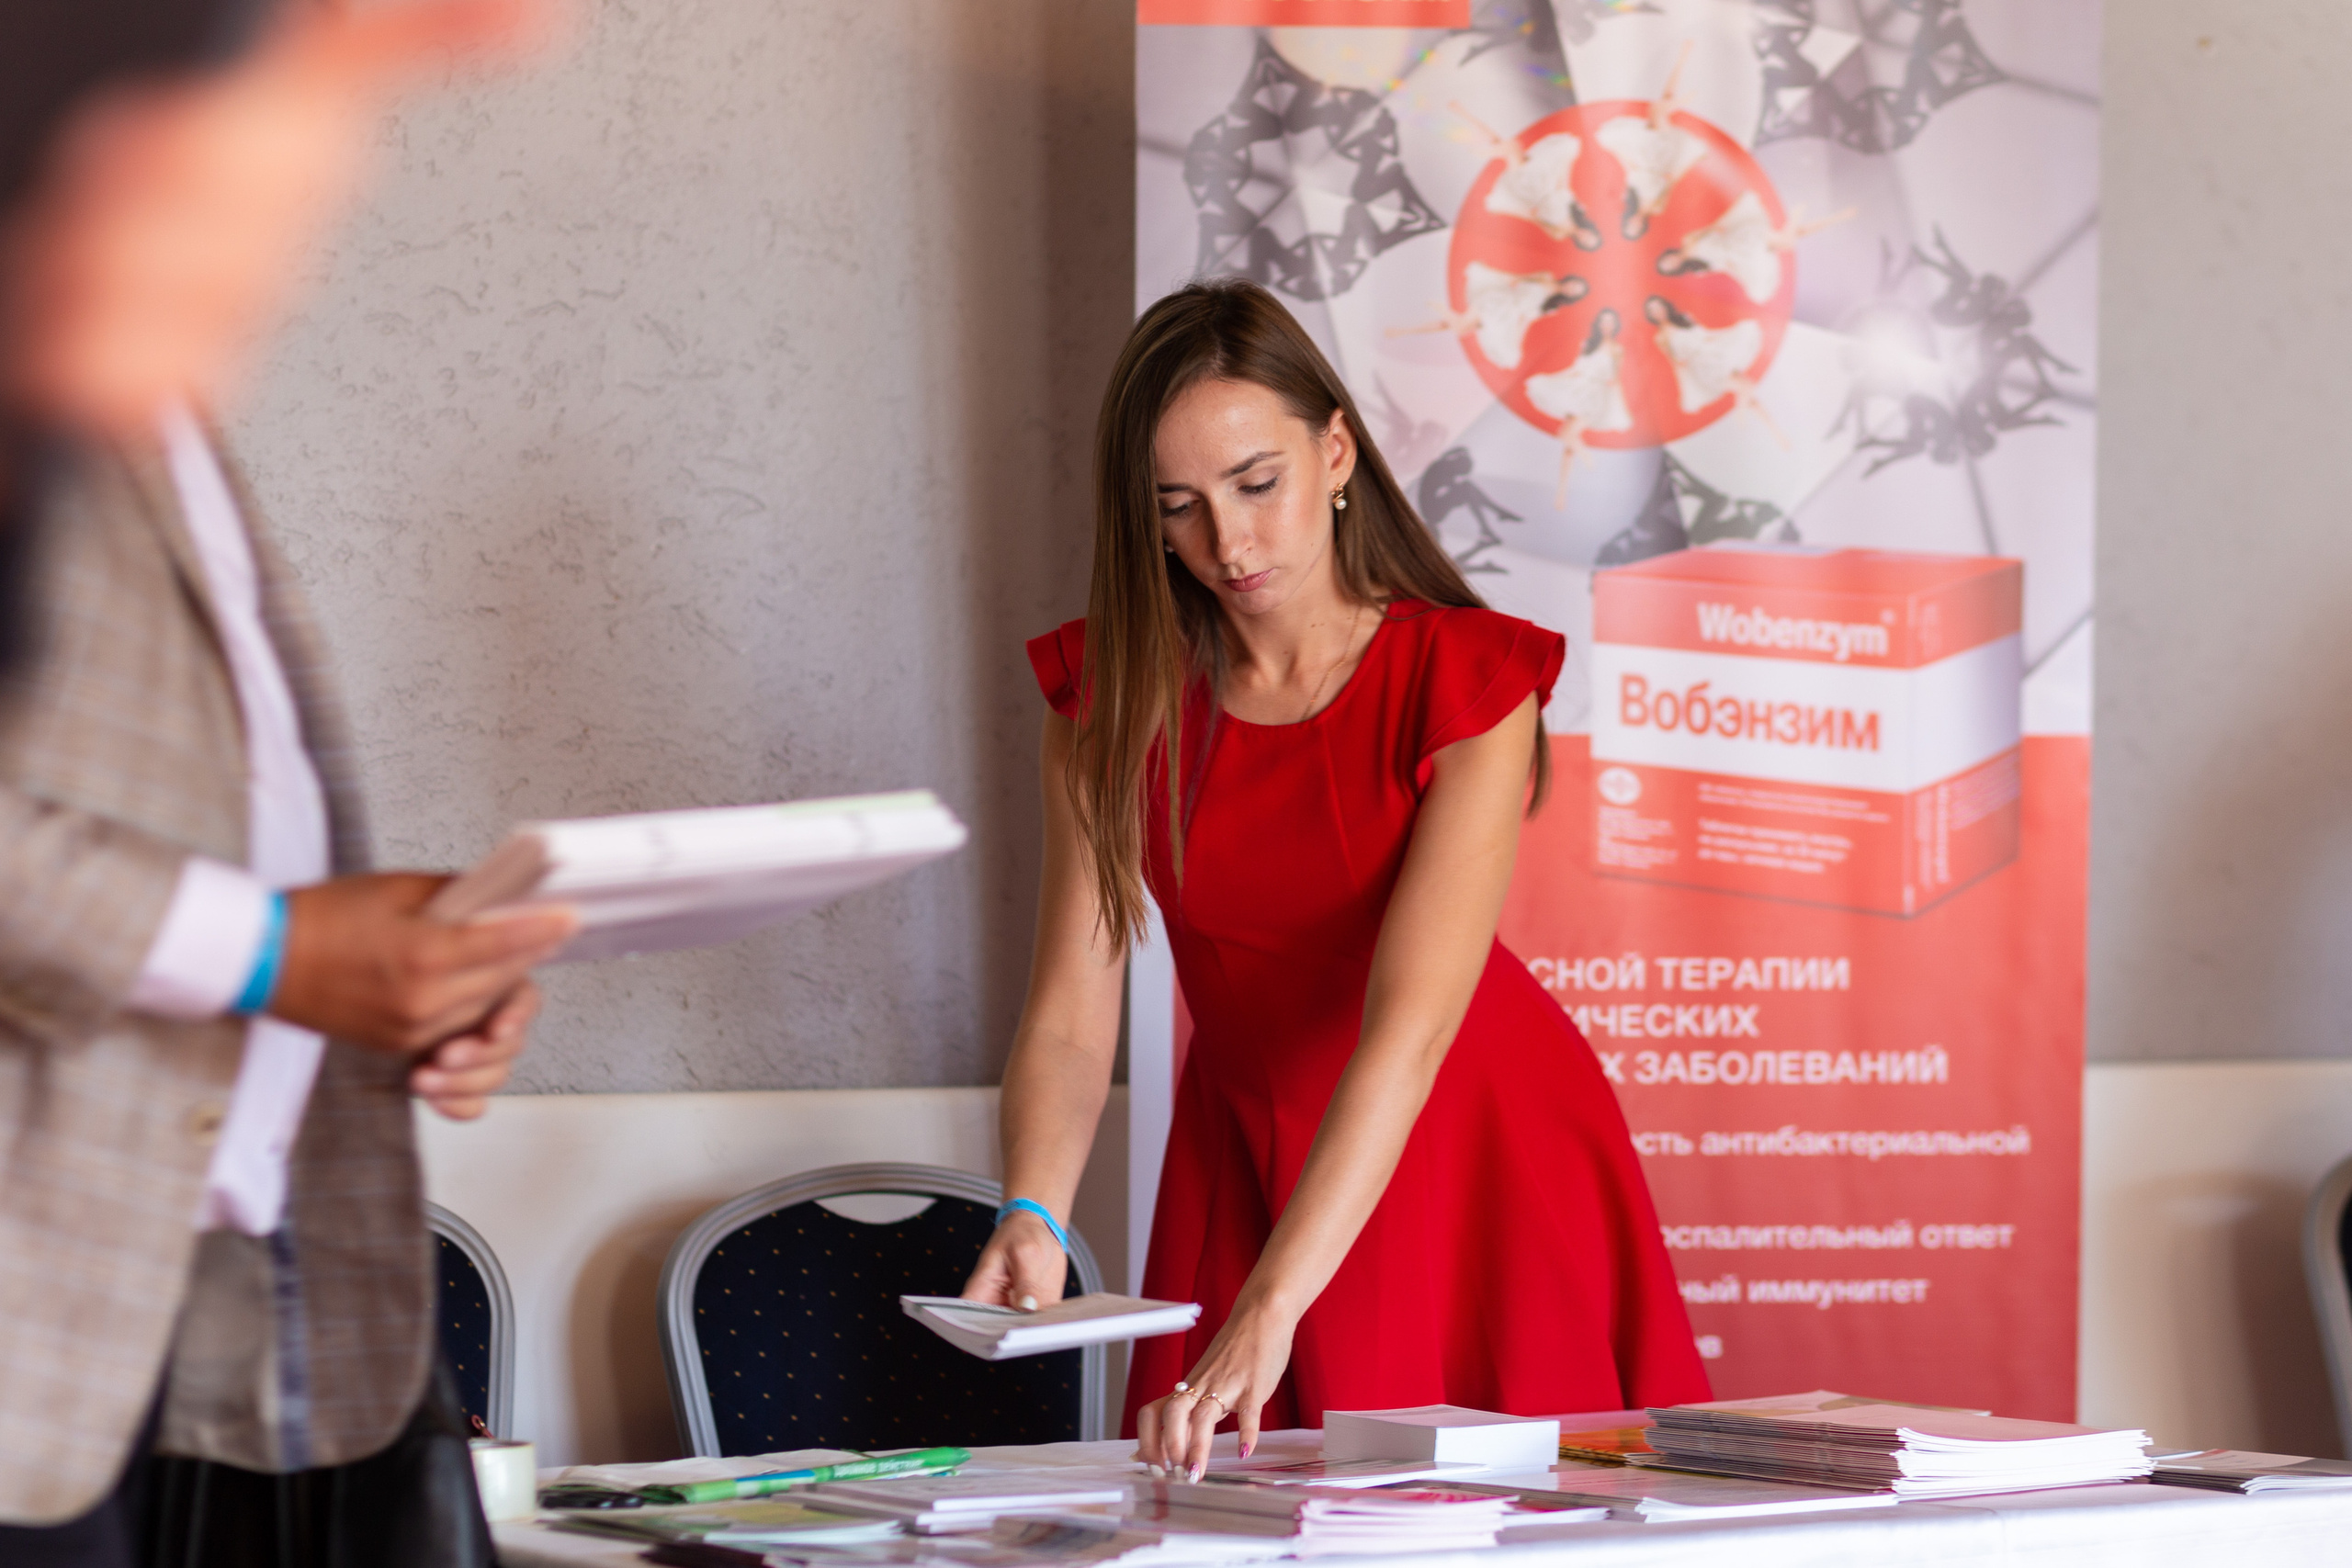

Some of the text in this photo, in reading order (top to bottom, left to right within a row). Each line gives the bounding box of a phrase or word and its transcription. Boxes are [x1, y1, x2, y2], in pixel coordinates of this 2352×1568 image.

[1697, 603, 1889, 661] Wobenzym
[1620, 672, 1883, 752] Вобэнзим
[1657, 957, 1851, 991] ТЕРАПИИ
[1633, 1045, 1950, 1085] ЗАБОЛЕВАНИЙ
[1630, 1125, 2030, 1159] сть антибактериальной
[1919, 1224, 2015, 1249] ответ
[1747, 1280, 1928, 1310] иммунитет
